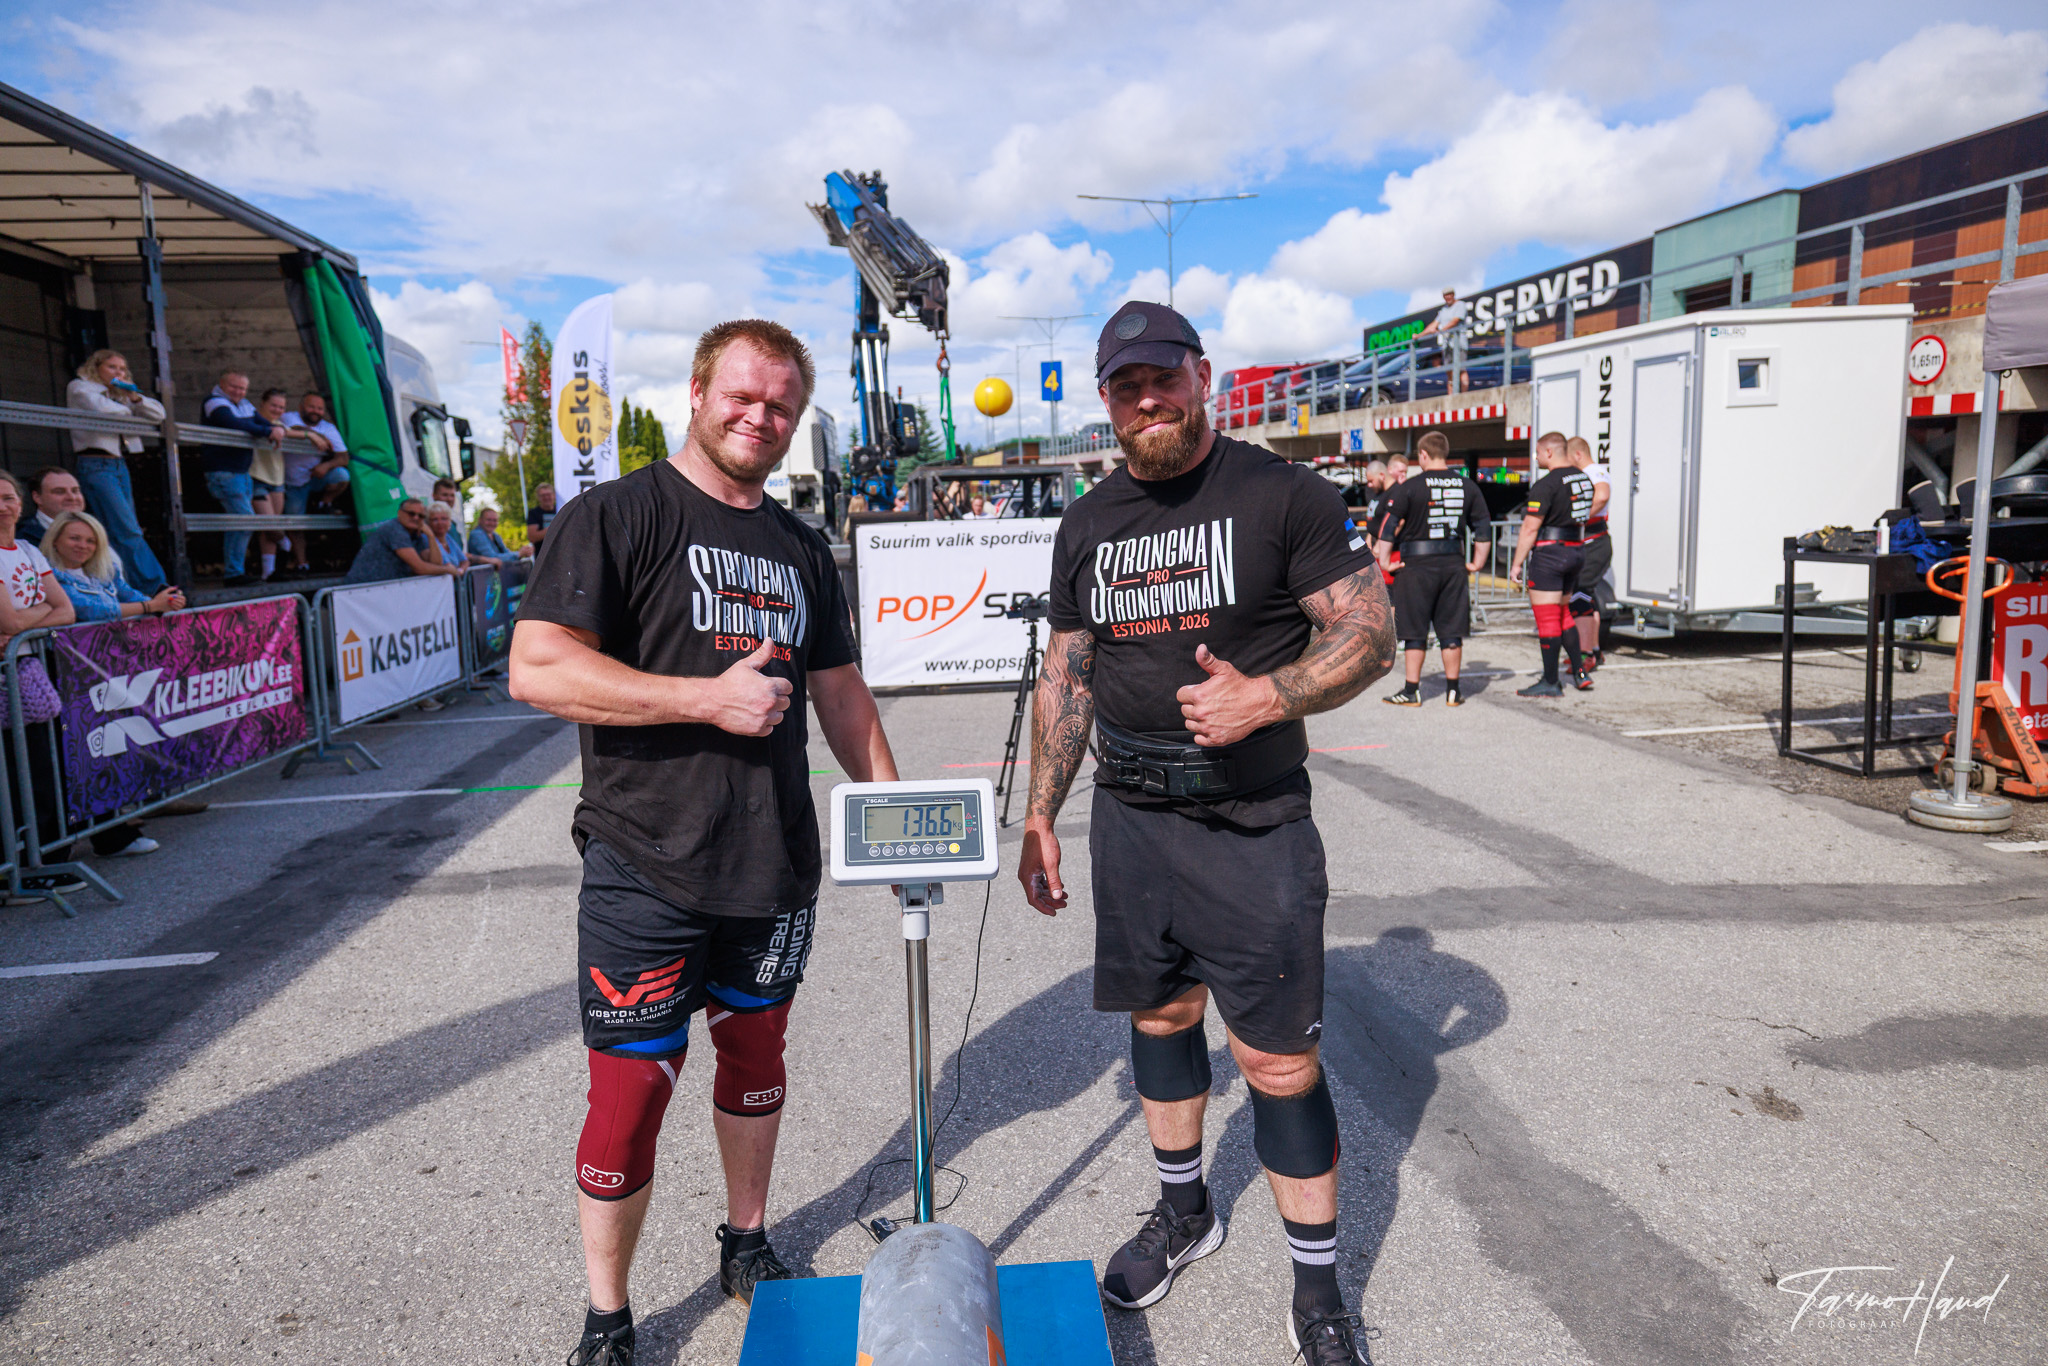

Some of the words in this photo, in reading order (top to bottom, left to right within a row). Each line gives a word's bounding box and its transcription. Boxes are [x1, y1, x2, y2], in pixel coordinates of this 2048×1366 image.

[1044, 370, 1059, 391] 4
[1598, 356, 1613, 473] RLING
[870, 535, 930, 549] Suurim
[937, 533, 974, 547] valik
[1091, 518, 1235, 605] STRONGMAN
[1147, 569, 1170, 585] PRO
[1091, 566, 1235, 624] STRONGWOMAN
[877, 595, 955, 622] POP
[1112, 618, 1171, 637] ESTONIA
[1179, 613, 1210, 631] 2026
[369, 616, 456, 673] KASTELLI
[780, 908, 808, 978] GOING
[589, 1010, 636, 1018] VOSTOK
[635, 1008, 672, 1022] LITHUANIA
[744, 1086, 783, 1106] SBD
